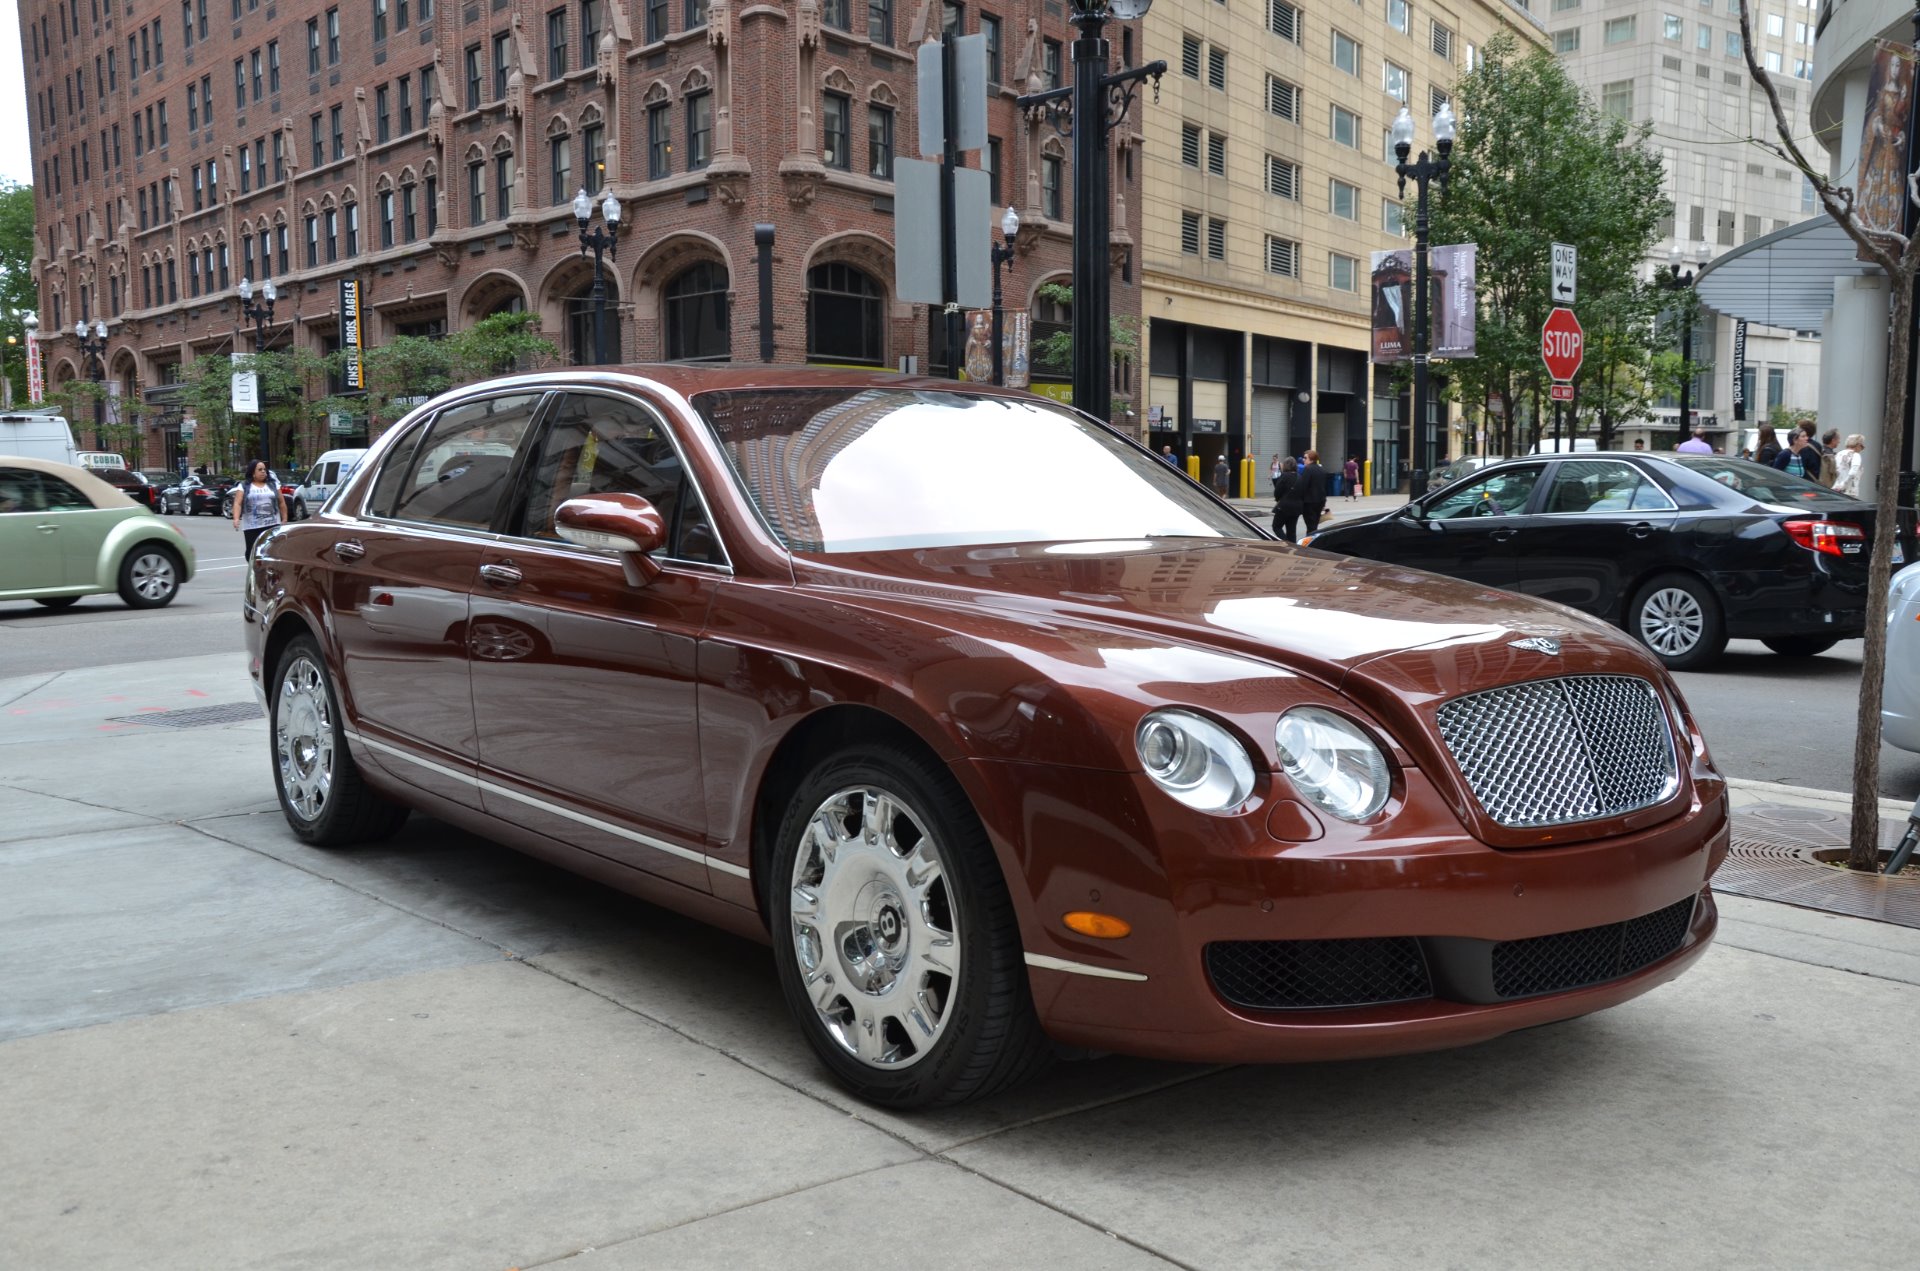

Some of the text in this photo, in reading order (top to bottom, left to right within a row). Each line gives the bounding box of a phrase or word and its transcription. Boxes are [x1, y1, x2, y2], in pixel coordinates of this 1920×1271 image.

[1555, 248, 1573, 264] ONE
[1555, 265, 1573, 280] WAY
[344, 281, 356, 316] BAGELS
[1380, 341, 1401, 349] LUMA
[1545, 330, 1580, 358] STOP
[29, 336, 41, 404] HERSHE
[1733, 323, 1745, 404] NORDSTROM rack
[239, 371, 251, 402] LUM
[1552, 387, 1571, 398] ALL WAY
[93, 455, 121, 465] COBRA
